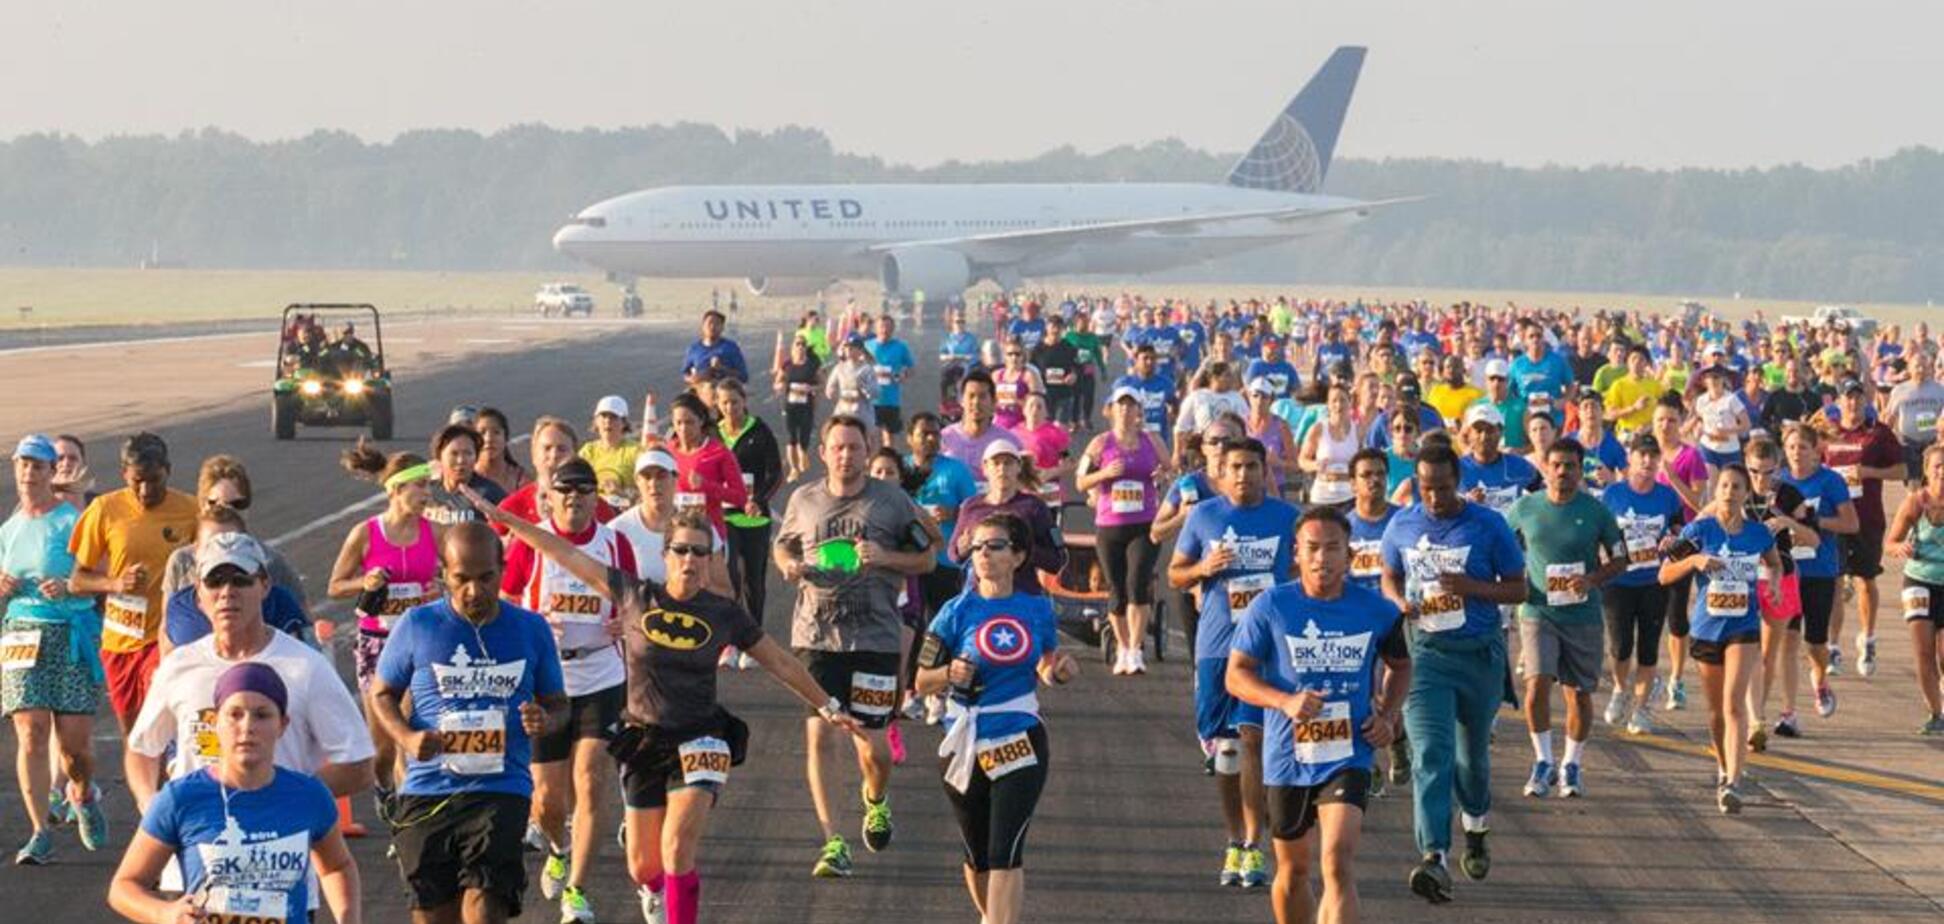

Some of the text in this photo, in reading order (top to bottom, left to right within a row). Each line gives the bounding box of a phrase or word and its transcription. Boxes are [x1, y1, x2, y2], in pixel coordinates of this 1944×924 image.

[704, 199, 864, 221] UNITED
[555, 593, 602, 615] 2120
[1709, 594, 1746, 609] 2234
[1295, 646, 1362, 659] 5K 10K
[442, 675, 517, 687] 5K 10K
[854, 688, 894, 707] 2634
[443, 730, 503, 754] 2734
[1296, 719, 1350, 743] 2644
[686, 752, 729, 773] 2487
[979, 739, 1030, 771] 2488
[212, 851, 304, 875] 5K 10K
